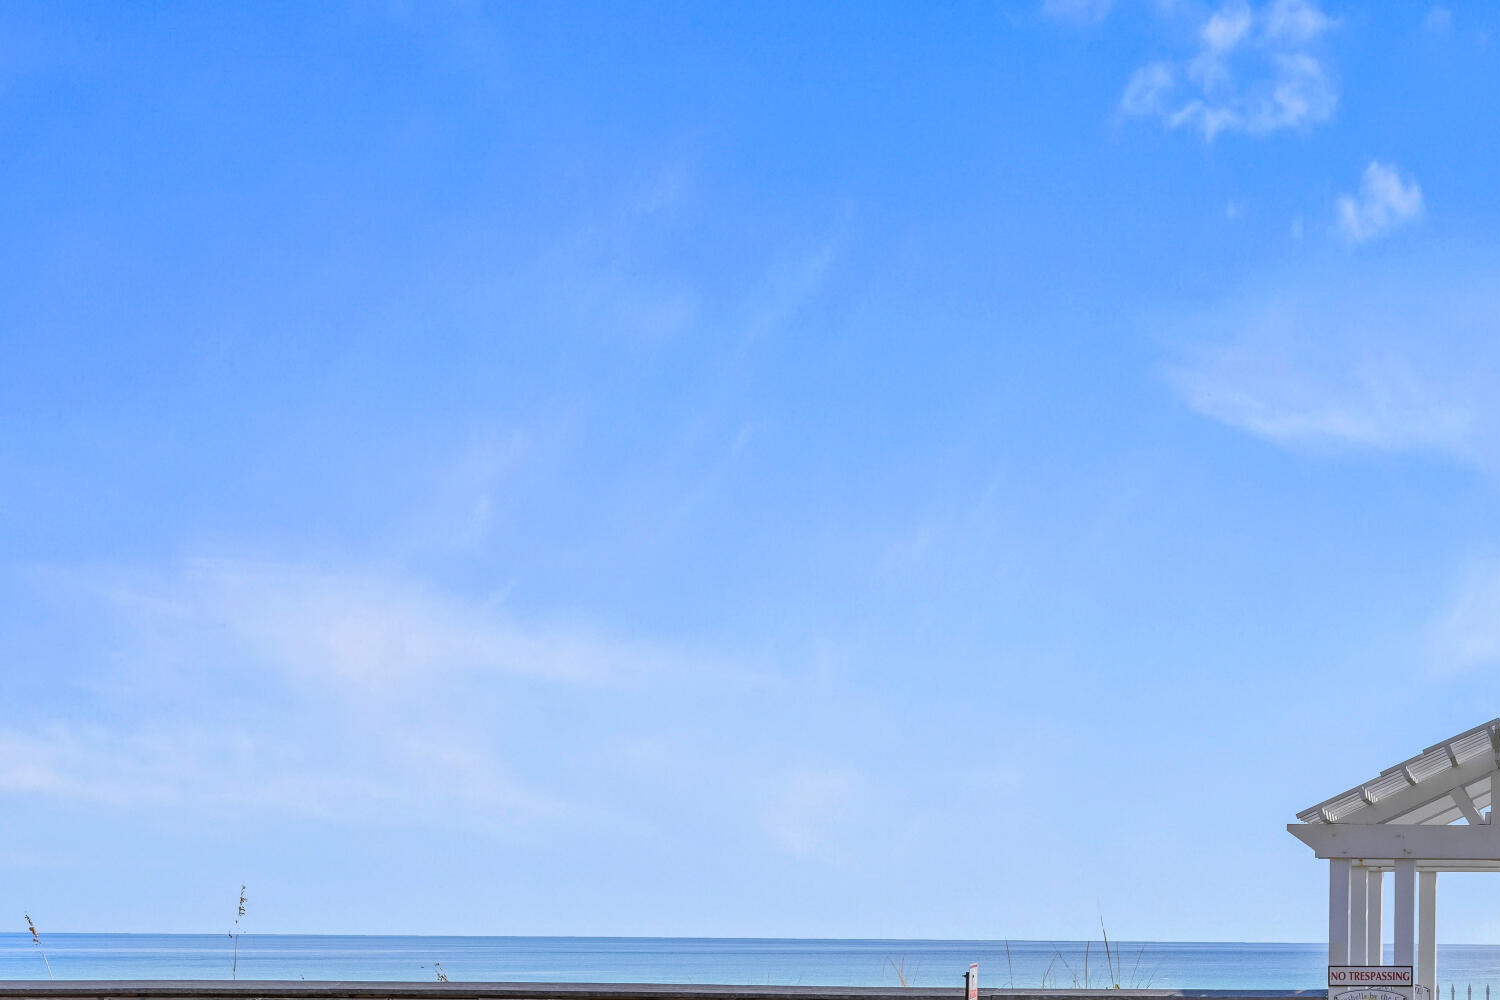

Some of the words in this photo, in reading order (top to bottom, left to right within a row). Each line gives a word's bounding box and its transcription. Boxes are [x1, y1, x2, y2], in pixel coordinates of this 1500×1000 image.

[1331, 971, 1346, 981] NO
[1349, 971, 1410, 981] TRESPASSING
[1370, 992, 1377, 1000] by
[1381, 993, 1392, 1000] the
